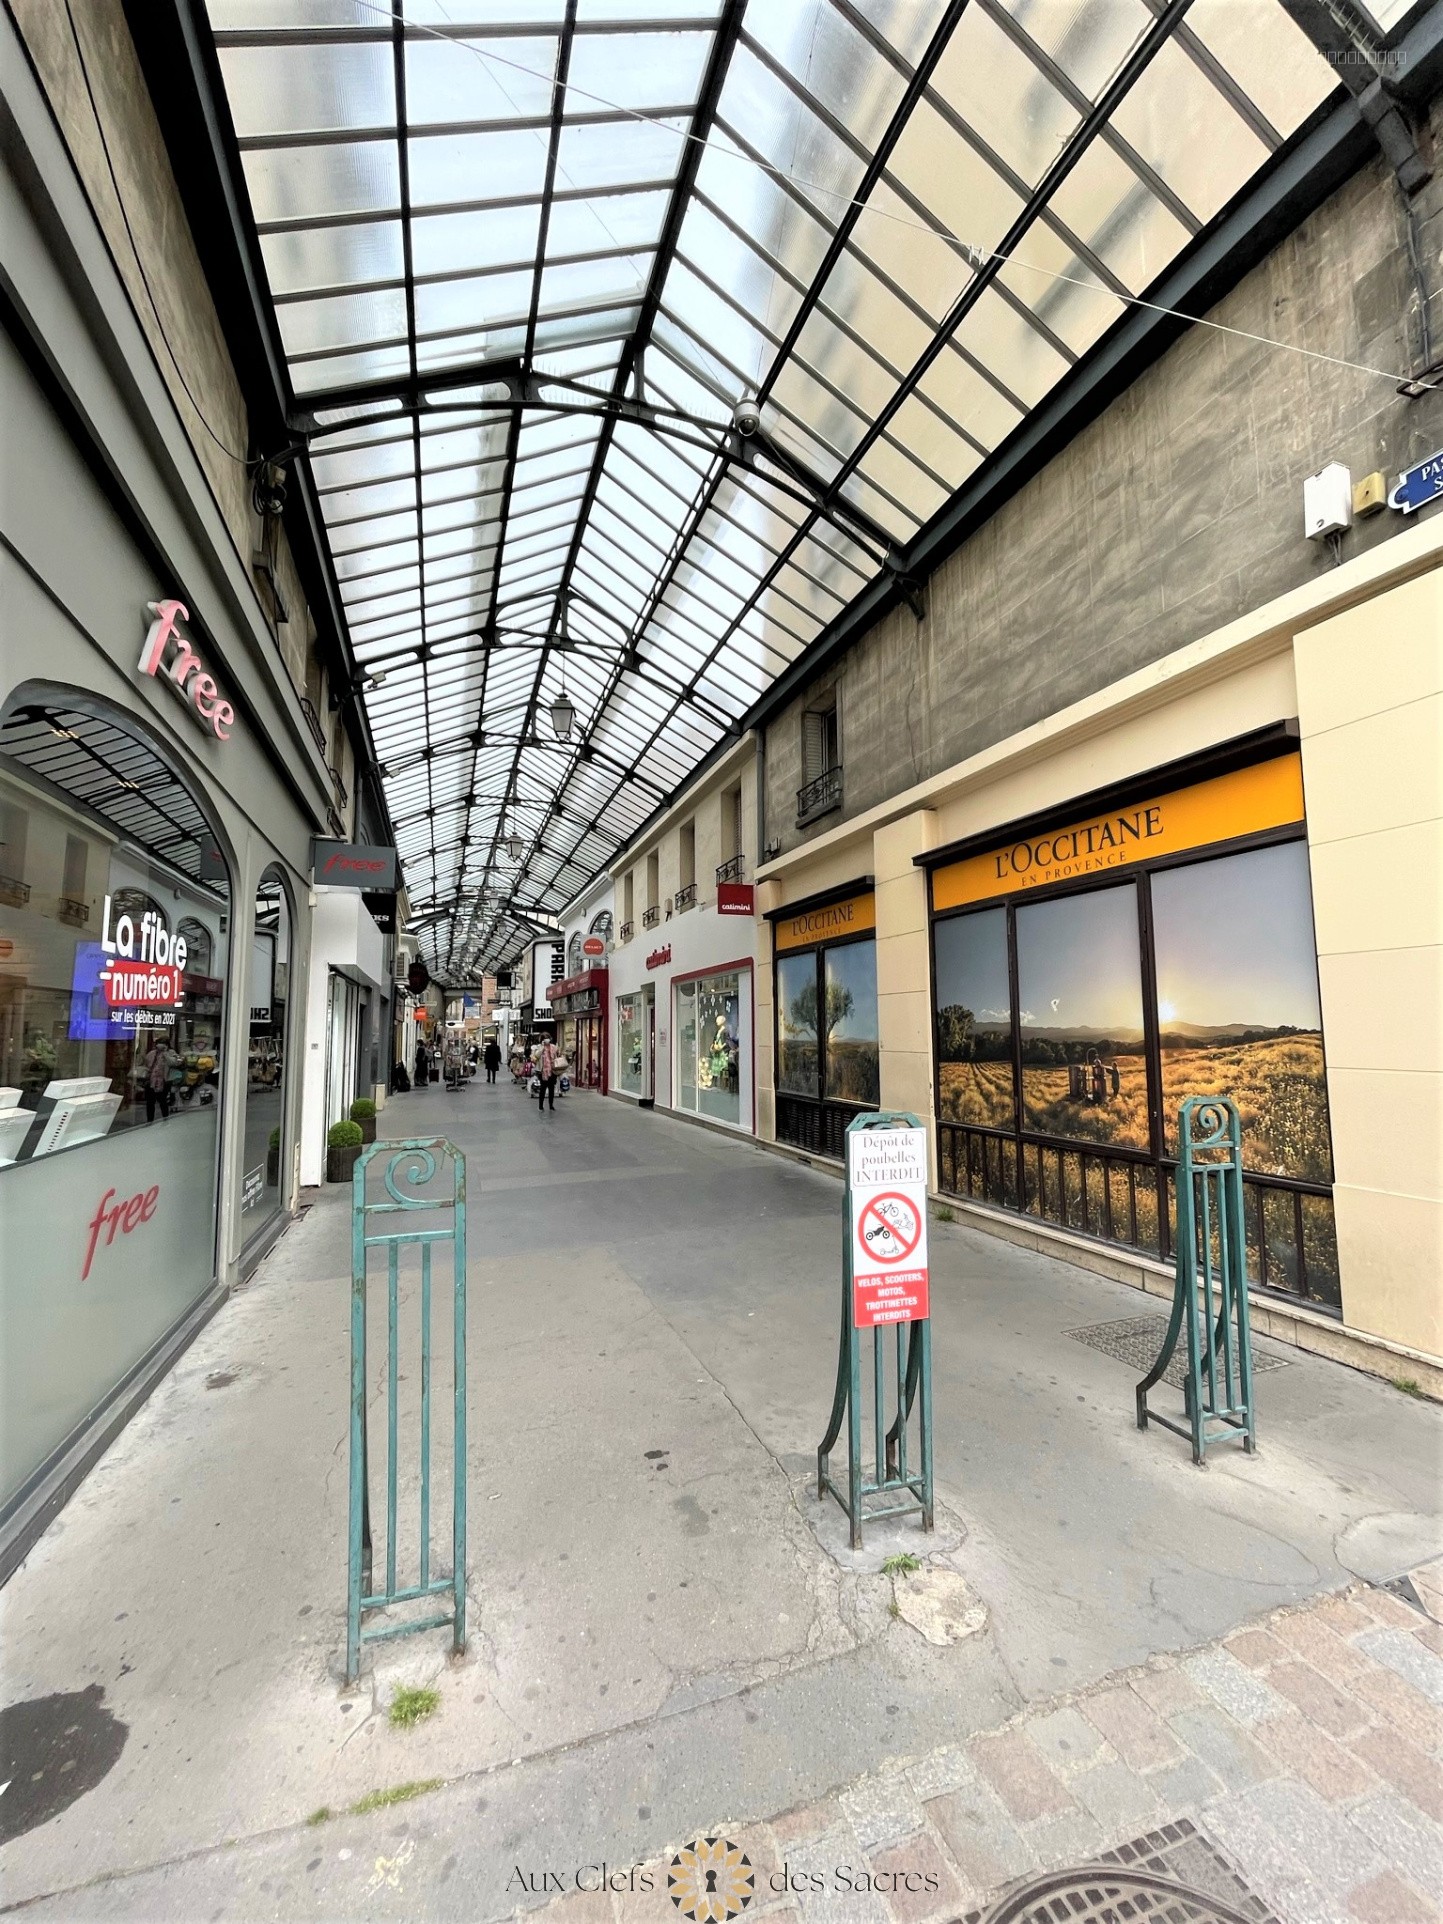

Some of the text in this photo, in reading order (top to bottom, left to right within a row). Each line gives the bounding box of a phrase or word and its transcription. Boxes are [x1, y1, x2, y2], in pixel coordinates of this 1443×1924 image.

[1421, 457, 1443, 481] PA
[137, 600, 234, 741] free
[994, 806, 1164, 879] L'OCCITANE
[323, 851, 387, 875] free
[1021, 850, 1127, 887] EN PROVENCE
[721, 903, 751, 911] catimini
[792, 903, 854, 937] L'OCCITANE
[101, 894, 188, 971] La fibre
[112, 967, 171, 1001] numéro
[173, 969, 179, 1000] 1
[111, 1009, 176, 1025] sur les débits en 2021
[863, 1133, 914, 1151] Dépôt de
[861, 1151, 916, 1169] poubelles
[856, 1167, 922, 1183] INTERDIT
[81, 1185, 160, 1282] free
[858, 1272, 924, 1288] VELOS, SCOOTERS,
[877, 1286, 906, 1297] MOTOS,
[865, 1297, 918, 1311] TROTTINETTES
[873, 1309, 912, 1322] INTERDITS
